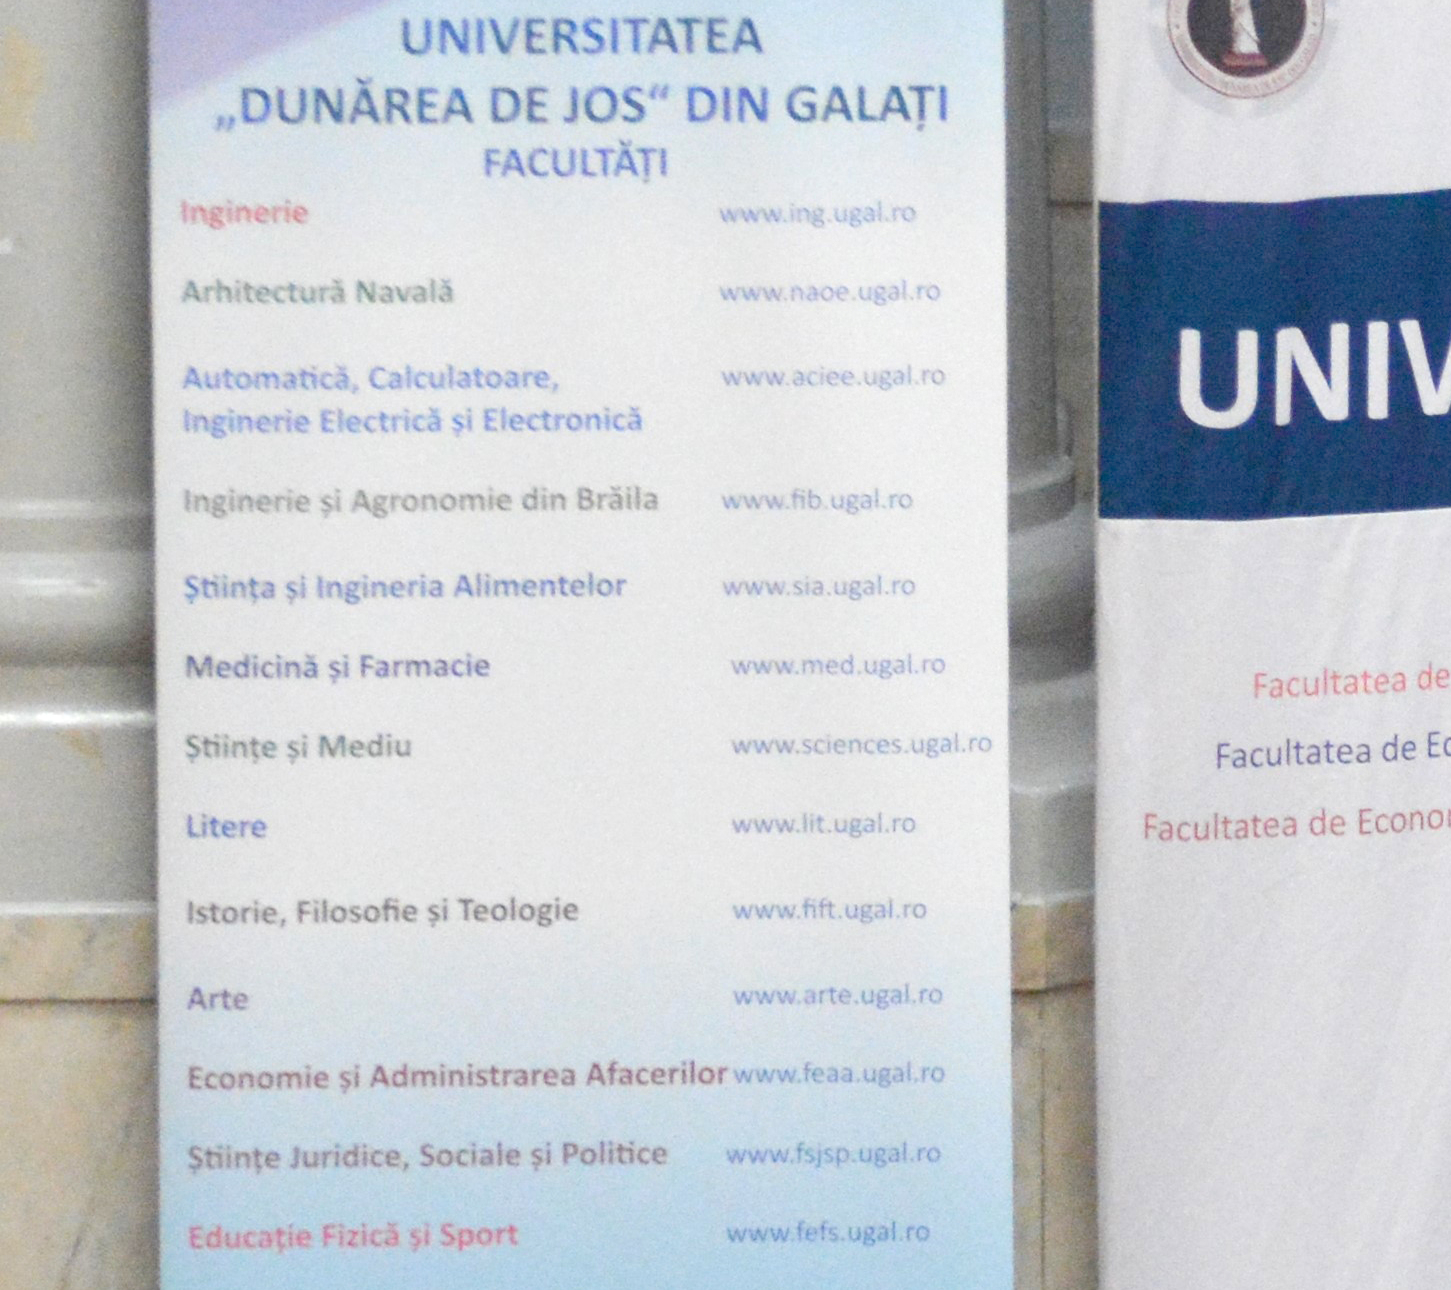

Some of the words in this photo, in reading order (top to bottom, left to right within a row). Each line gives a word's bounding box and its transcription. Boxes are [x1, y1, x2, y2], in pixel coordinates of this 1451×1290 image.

[402, 17, 764, 55] UNIVERSITATEA
[490, 86, 547, 123] DE
[687, 86, 768, 123] DIN
[786, 85, 948, 131] GALAȚI
[484, 141, 668, 182] FACULTĂȚI
[718, 201, 917, 228] www.ing.ugal.ro
[719, 279, 942, 307] www.naoe.ugal.ro
[721, 365, 946, 391] www.aciee.ugal.ro
[721, 488, 914, 516] www.fib.ugal.ro
[722, 574, 917, 602] www.sia.ugal.ro
[730, 653, 947, 680] www.med.ugal.ro
[1253, 667, 1407, 699] Facultatea
[1417, 662, 1451, 691] de
[731, 732, 993, 759] www.sciences.ugal.ro
[1216, 738, 1372, 769] Facultatea
[1381, 734, 1417, 762] de
[731, 812, 917, 839] www.lit.ugal.ro
[1143, 812, 1299, 843] Facultatea
[1308, 808, 1347, 837] de
[733, 983, 944, 1011] www.arte.ugal.ro
[733, 1061, 946, 1088] www.feaa.ugal.ro
[726, 1141, 942, 1169] www.fsjsp.ugal.ro
[726, 1220, 932, 1247] www.fefs.ugal.ro
